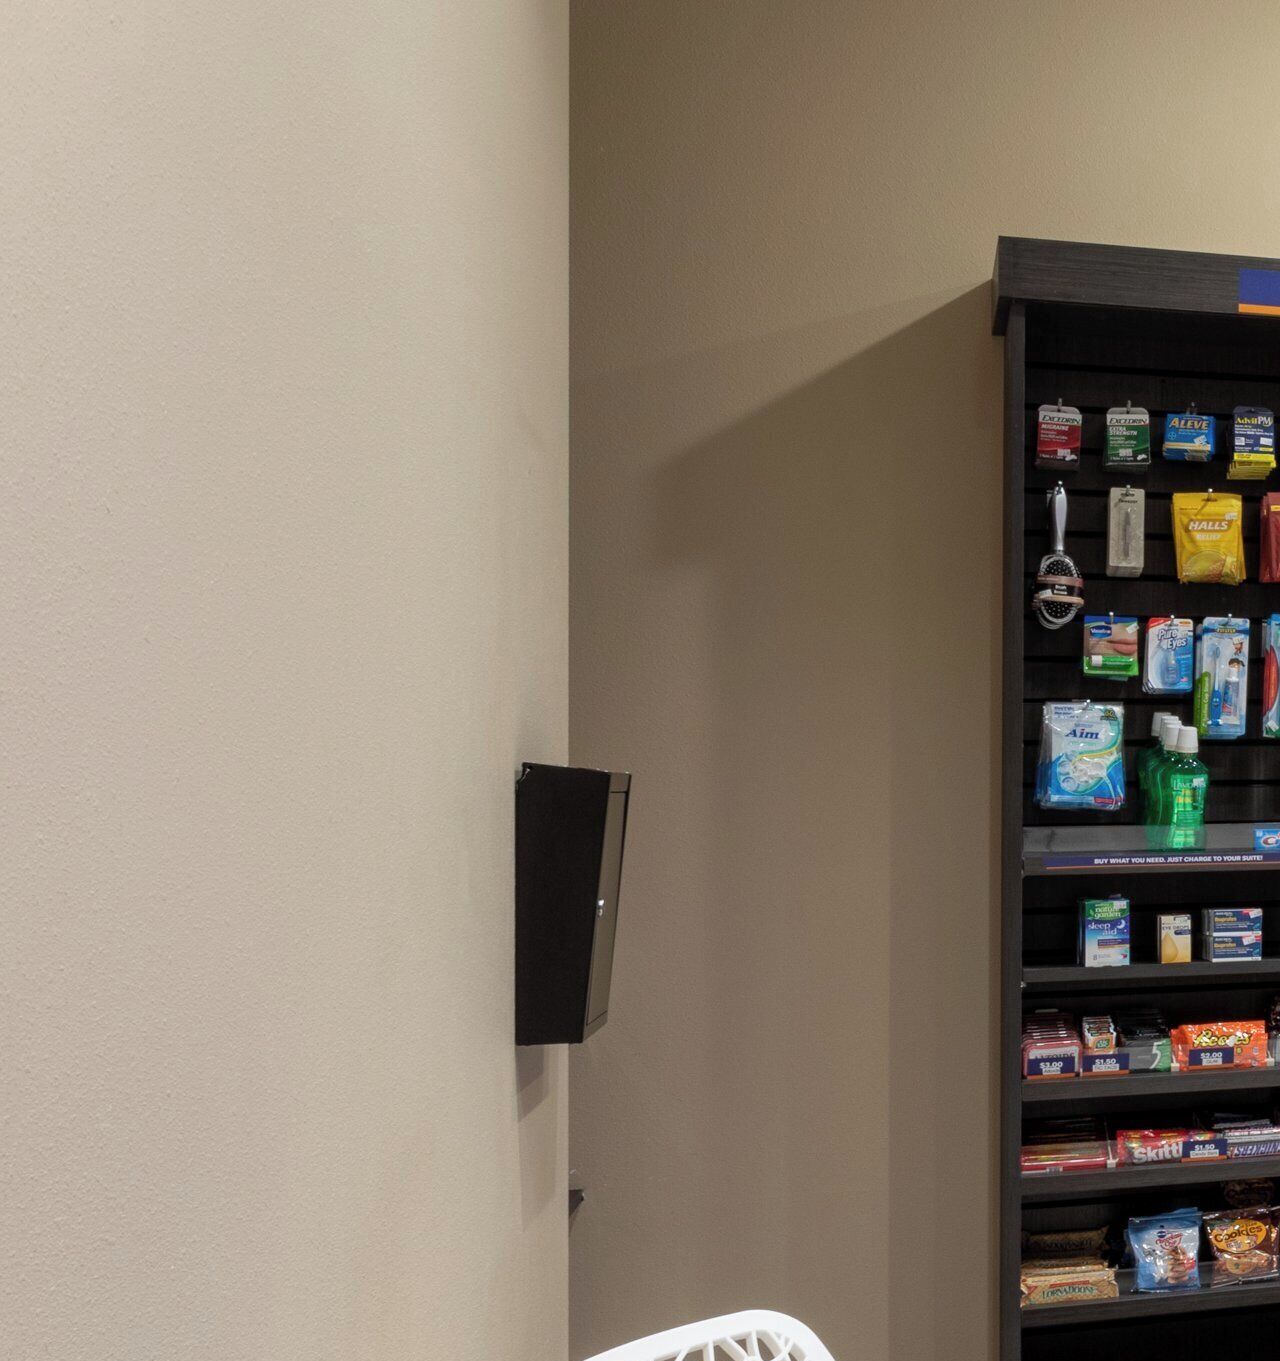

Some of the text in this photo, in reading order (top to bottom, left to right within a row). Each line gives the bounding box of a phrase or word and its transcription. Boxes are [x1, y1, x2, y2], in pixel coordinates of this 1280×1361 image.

[1168, 417, 1209, 430] ALEVE
[1188, 521, 1229, 530] HALLS
[1166, 638, 1187, 650] Eyes
[1065, 728, 1099, 739] Aim
[1088, 923, 1111, 931] sleep
[1040, 1061, 1063, 1069] $3.00
